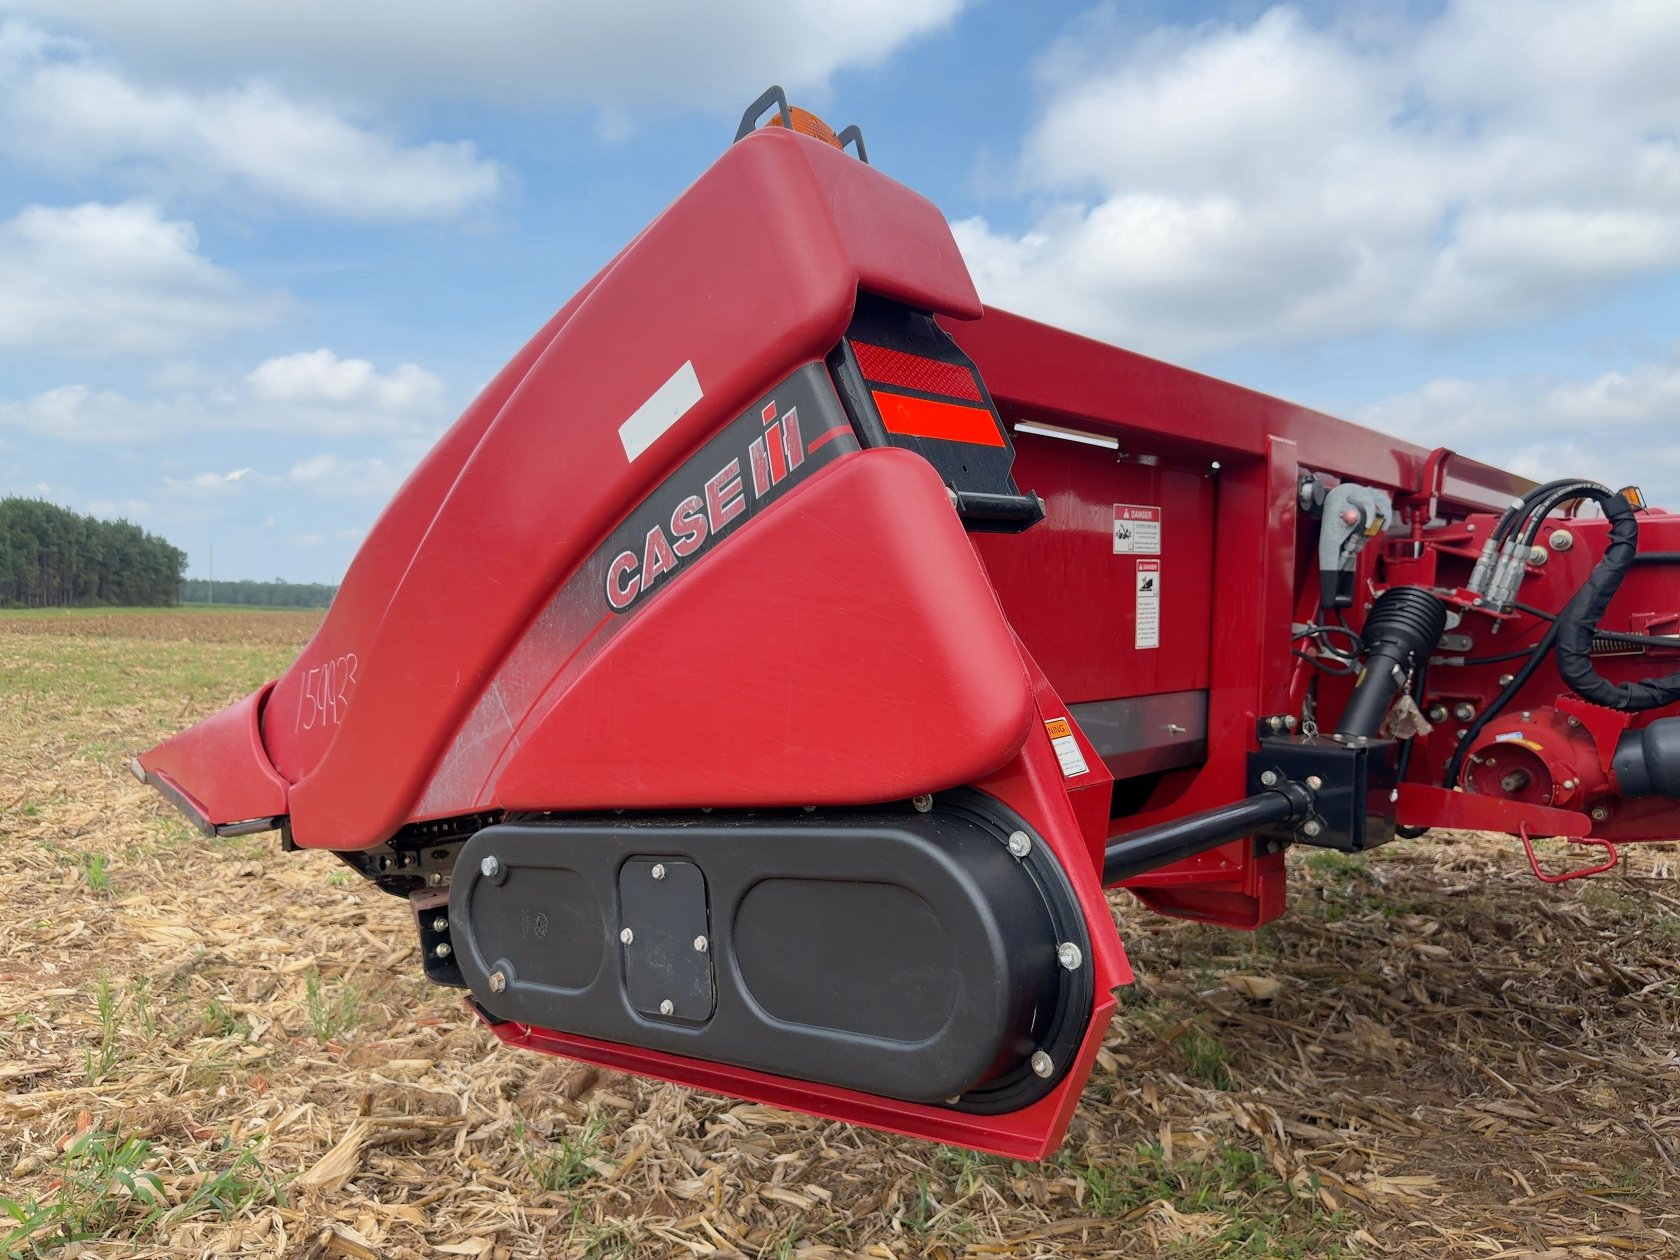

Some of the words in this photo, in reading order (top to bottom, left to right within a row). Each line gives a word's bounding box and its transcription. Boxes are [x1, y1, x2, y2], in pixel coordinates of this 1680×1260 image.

[1130, 509, 1152, 520] DANGER
[606, 457, 747, 609] CASE
[1047, 724, 1066, 736] NING
